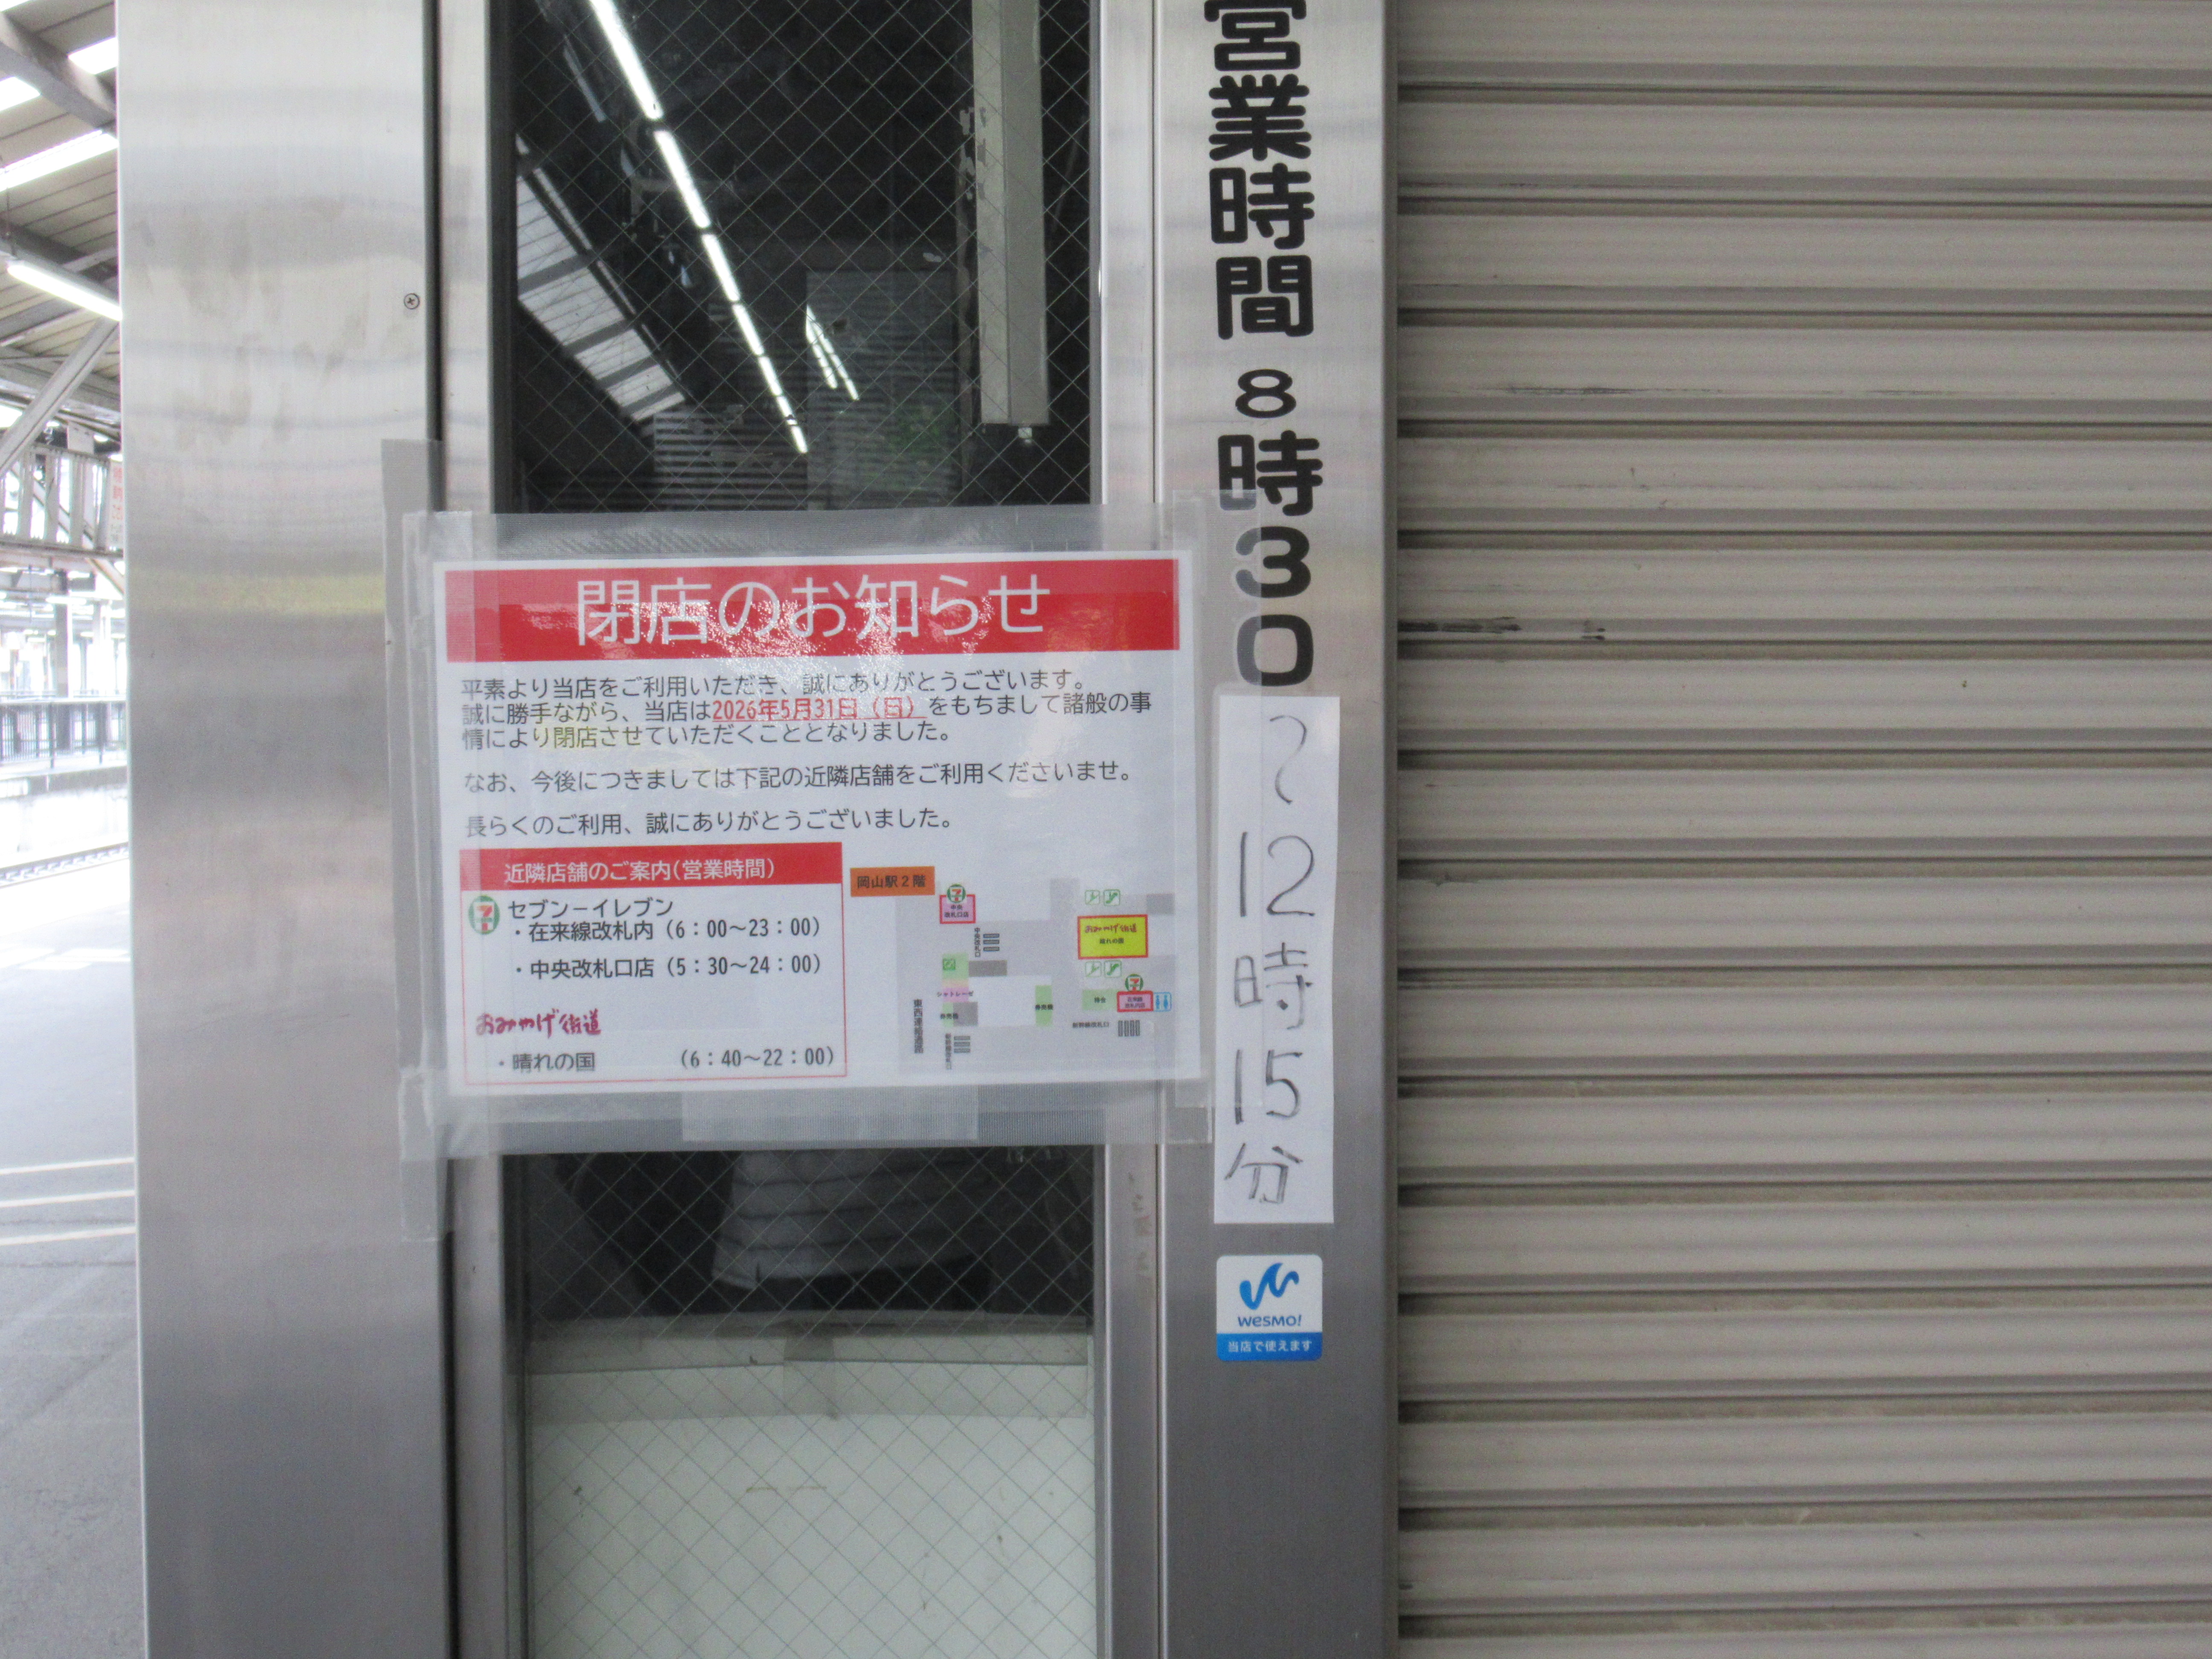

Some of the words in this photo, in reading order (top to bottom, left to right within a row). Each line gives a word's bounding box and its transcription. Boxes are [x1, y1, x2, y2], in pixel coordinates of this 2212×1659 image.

[577, 574, 1050, 646] 閉店のお知らせ
[461, 669, 1084, 699] 平素より当店をご利用いただき、誠にありがとうございます。
[462, 721, 949, 750] 情により閉店させていただくこととなりました。
[465, 760, 1129, 793] なお、今後につきましては下記の近隣店舗をご利用くださいませ。
[467, 807, 951, 837] 長らくのご利用、誠にありがとうございました。
[857, 875, 926, 888] 岡山駅2階
[476, 1008, 602, 1039] おみやげ街道
[1228, 1341, 1312, 1352] 当店で使えます
